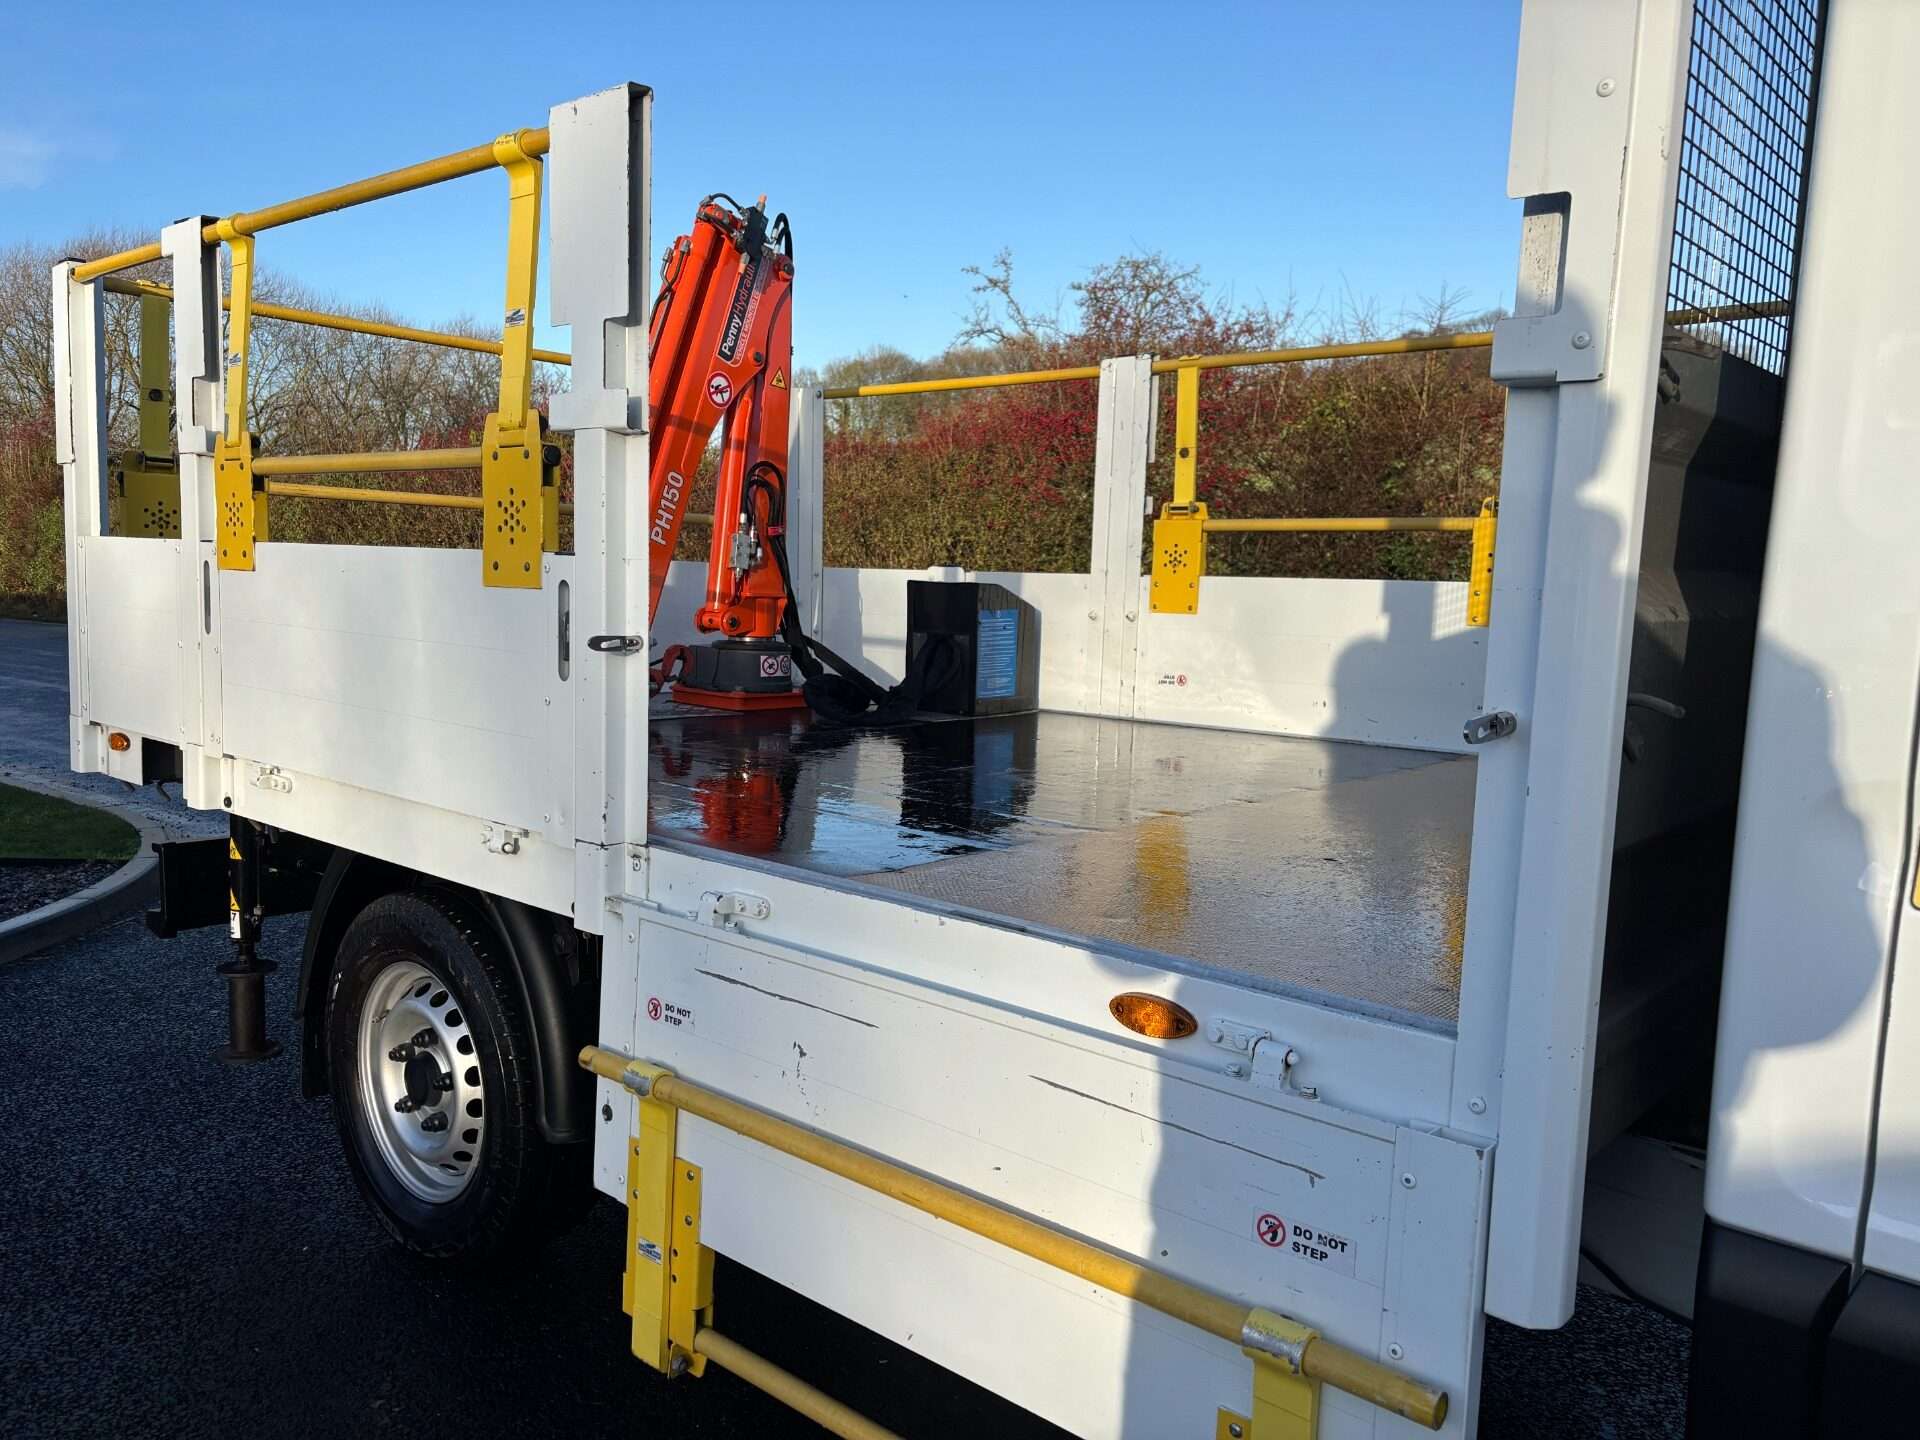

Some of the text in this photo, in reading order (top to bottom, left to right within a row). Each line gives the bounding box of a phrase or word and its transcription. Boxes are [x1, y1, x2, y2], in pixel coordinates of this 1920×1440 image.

[650, 471, 684, 545] PH150
[664, 1014, 682, 1027] STEP
[665, 1003, 691, 1019] DO NOT
[1293, 1224, 1348, 1253] DO NOT
[1291, 1241, 1328, 1261] STEP
